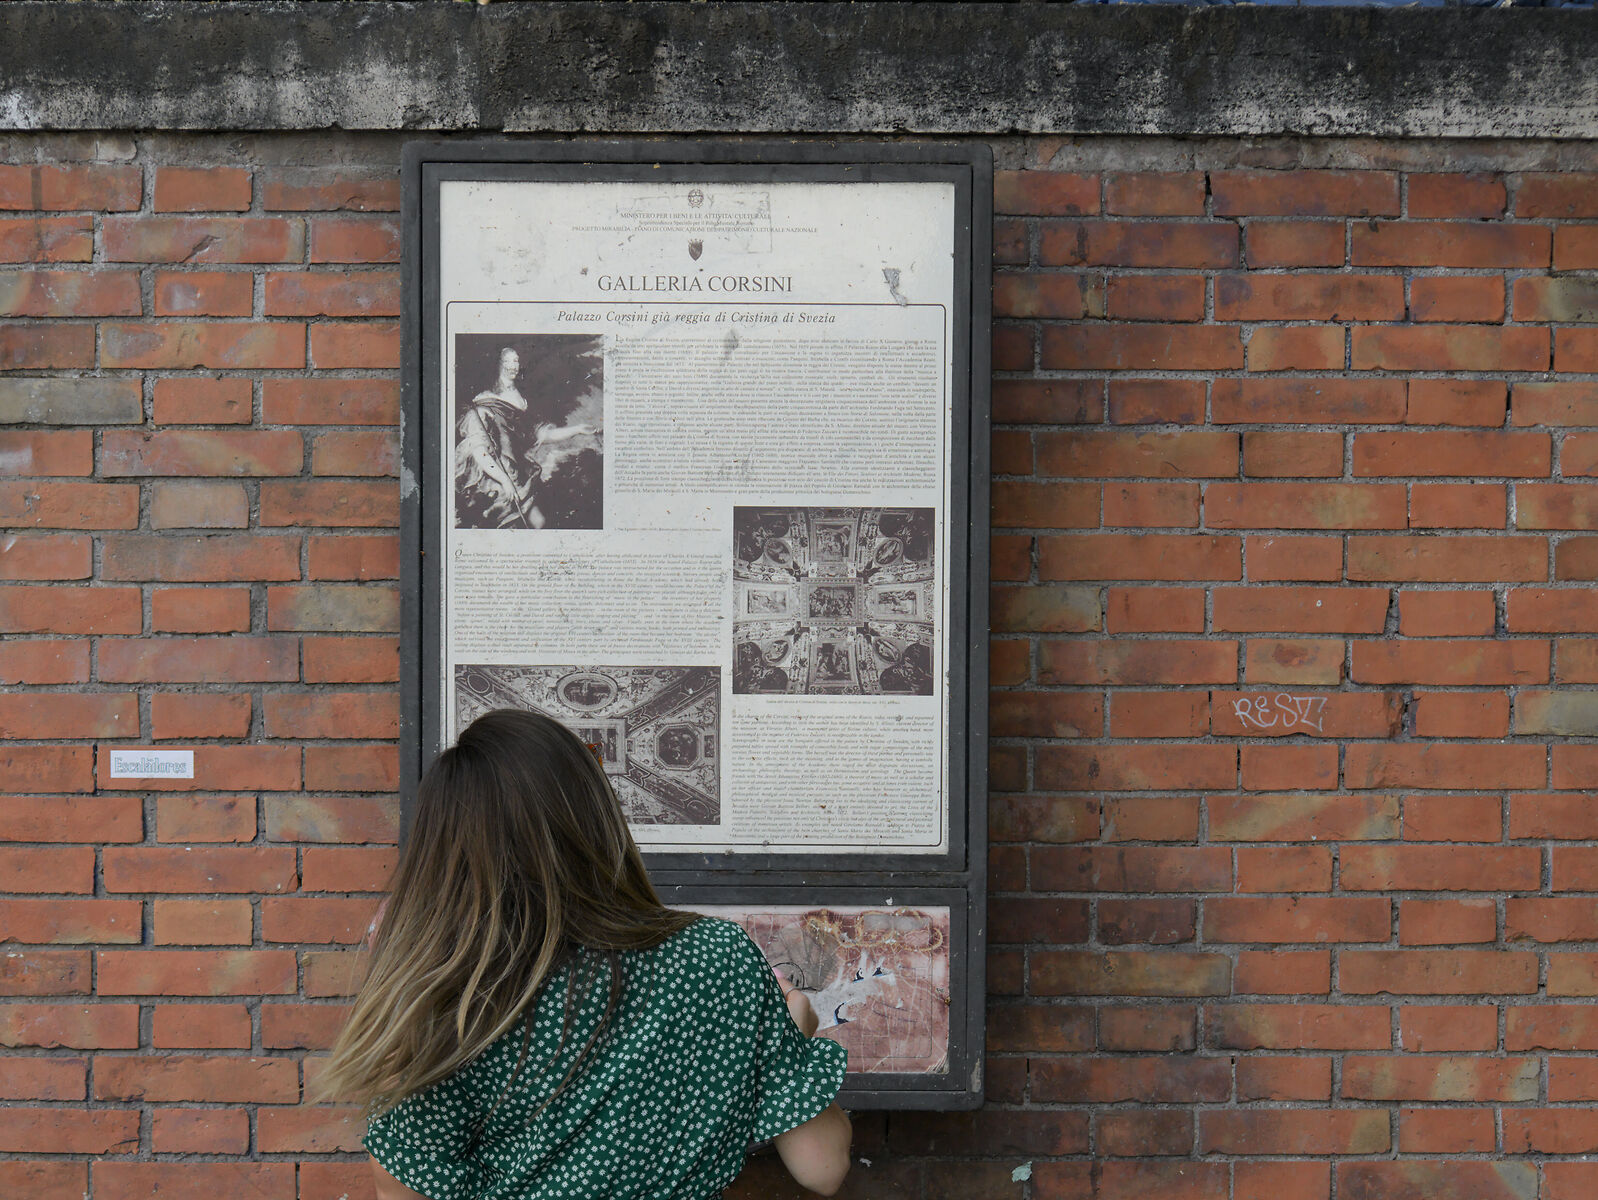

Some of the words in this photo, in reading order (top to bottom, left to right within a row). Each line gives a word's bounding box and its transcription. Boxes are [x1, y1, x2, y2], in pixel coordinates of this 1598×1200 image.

[597, 275, 703, 292] GALLERIA
[707, 276, 792, 292] CORSINI
[557, 310, 602, 321] Palazzo
[606, 311, 649, 322] Corsini
[651, 311, 670, 325] già
[675, 312, 710, 325] reggia
[715, 311, 727, 322] di
[730, 311, 778, 323] Cristina
[782, 312, 794, 323] di
[798, 312, 836, 324] Svezia
